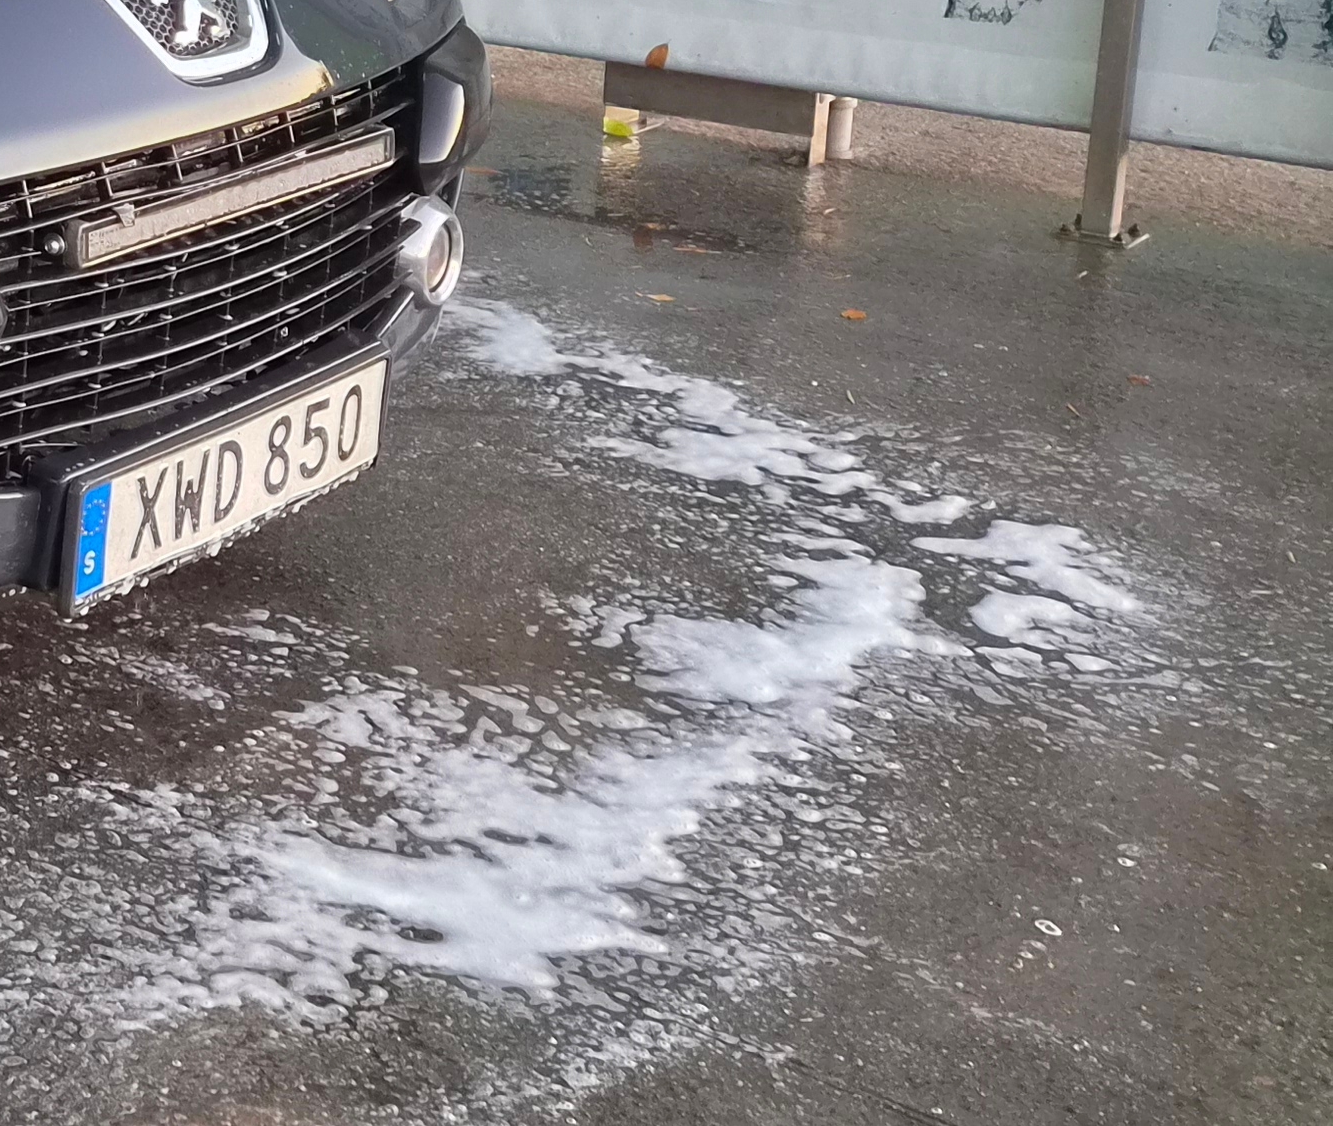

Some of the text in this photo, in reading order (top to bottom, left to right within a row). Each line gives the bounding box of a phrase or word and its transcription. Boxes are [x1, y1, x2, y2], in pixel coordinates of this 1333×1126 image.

[129, 383, 363, 561] XWD 850
[83, 549, 96, 576] S
